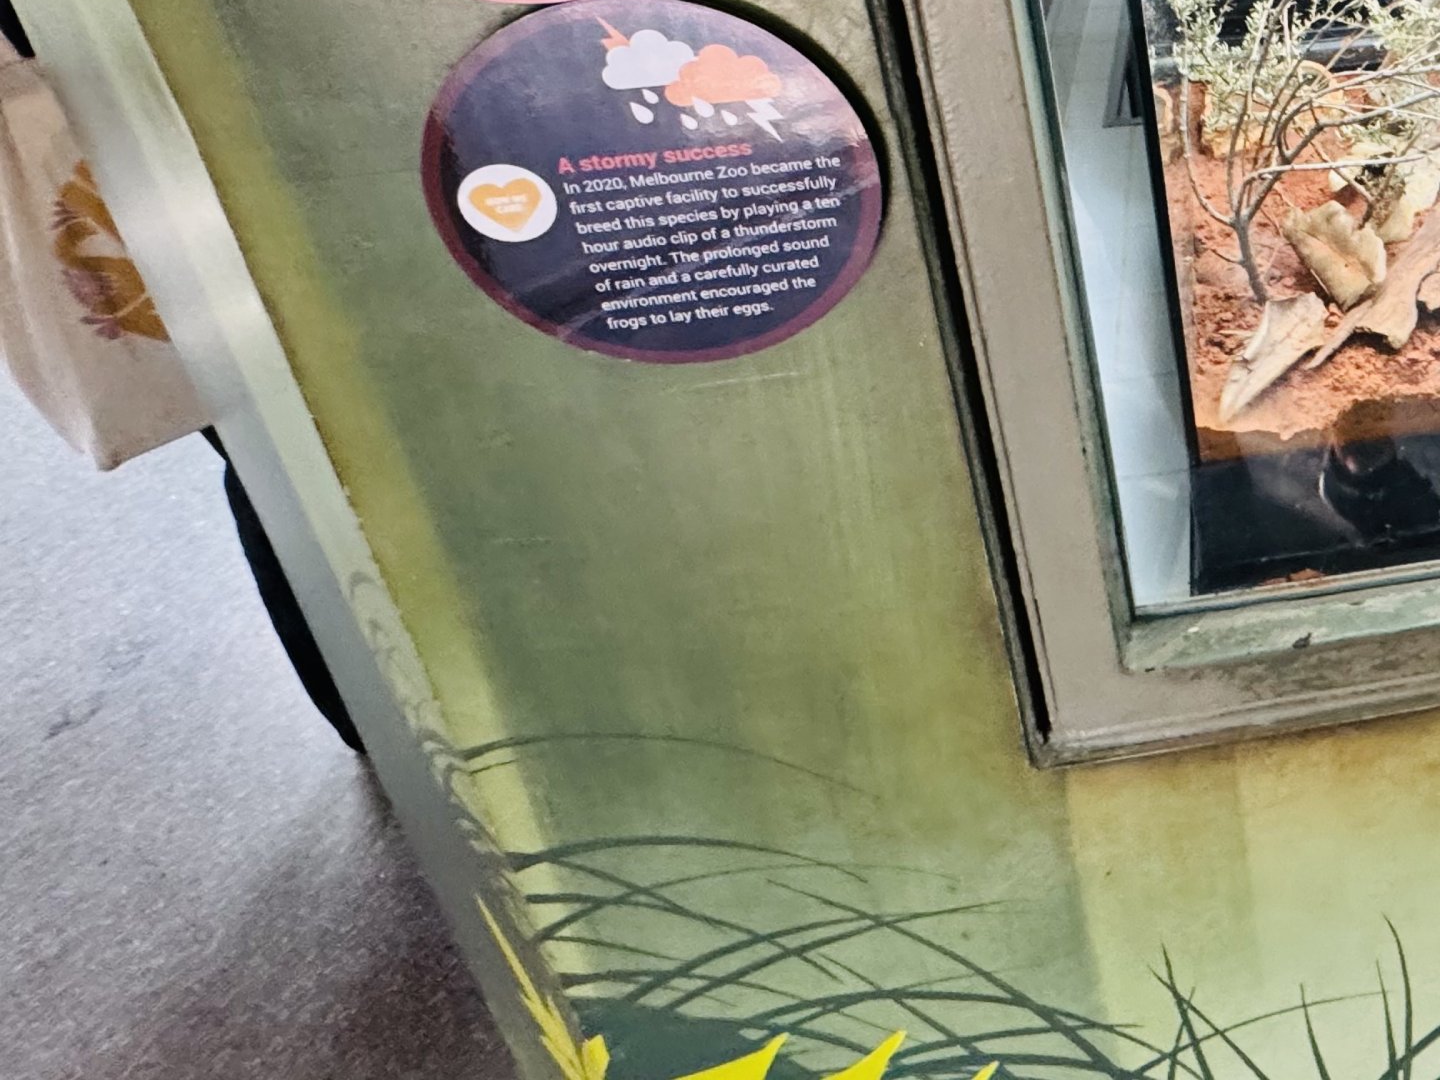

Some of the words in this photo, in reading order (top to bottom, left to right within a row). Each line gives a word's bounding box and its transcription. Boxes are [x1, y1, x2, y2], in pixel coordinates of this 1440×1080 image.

[558, 156, 574, 175] A
[579, 151, 657, 173] stormy
[663, 142, 752, 164] success
[564, 181, 581, 195] In
[584, 176, 627, 193] 2020,
[630, 169, 713, 189] Melbourne
[717, 165, 748, 178] Zoo
[751, 159, 812, 175] became
[815, 155, 841, 168] the
[569, 200, 602, 215] first
[605, 194, 663, 214] captive
[666, 187, 718, 205] facility
[722, 186, 739, 198] to
[742, 175, 837, 196] successfully
[575, 220, 622, 234] breed
[624, 214, 655, 229] this
[658, 208, 717, 227] species
[720, 205, 740, 220] by
[743, 199, 799, 217] playing
[803, 200, 812, 209] a
[815, 196, 840, 208] ten
[581, 240, 620, 254] hour
[623, 233, 667, 249] audio
[670, 229, 698, 245] clip
[701, 225, 718, 240] of
[721, 229, 730, 238] a
[734, 217, 837, 237] thunderstorm
[589, 251, 667, 273] overnight.
[669, 249, 700, 264] The
[703, 241, 779, 263] prolonged
[783, 235, 830, 252] sound
[594, 278, 612, 293] of
[614, 275, 646, 290] rain
[649, 271, 678, 286] and
[681, 273, 691, 283] a
[694, 263, 759, 282] carefully
[762, 255, 819, 273] curated
[601, 290, 698, 312] environment
[700, 280, 789, 301] encouraged
[791, 276, 816, 289] the
[606, 315, 647, 330] frogs
[651, 312, 667, 324] to
[669, 309, 692, 326] lay
[695, 305, 729, 319] their
[732, 302, 774, 318] eggs.
